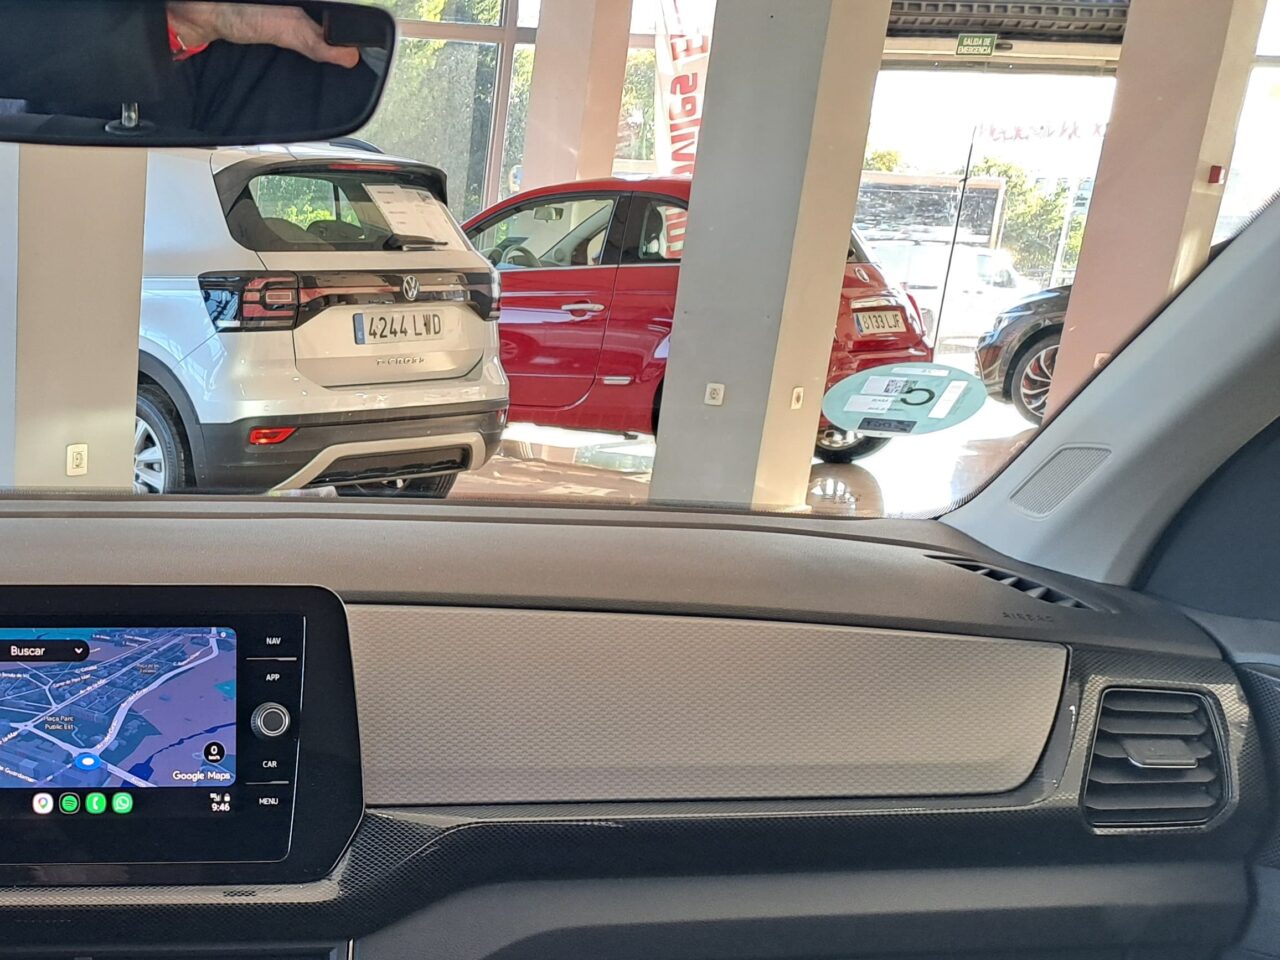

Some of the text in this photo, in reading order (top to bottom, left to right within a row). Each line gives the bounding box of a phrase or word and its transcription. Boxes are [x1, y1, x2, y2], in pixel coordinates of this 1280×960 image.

[862, 313, 900, 330] 8133 LJF
[368, 313, 442, 339] 4244 LWD
[266, 637, 281, 645] NAV
[10, 645, 45, 656] Buscar
[265, 673, 280, 681] APP
[262, 760, 277, 768] CAR
[173, 771, 230, 781] Google Maps
[259, 797, 278, 805] MENU
[211, 803, 230, 811] 9:46
